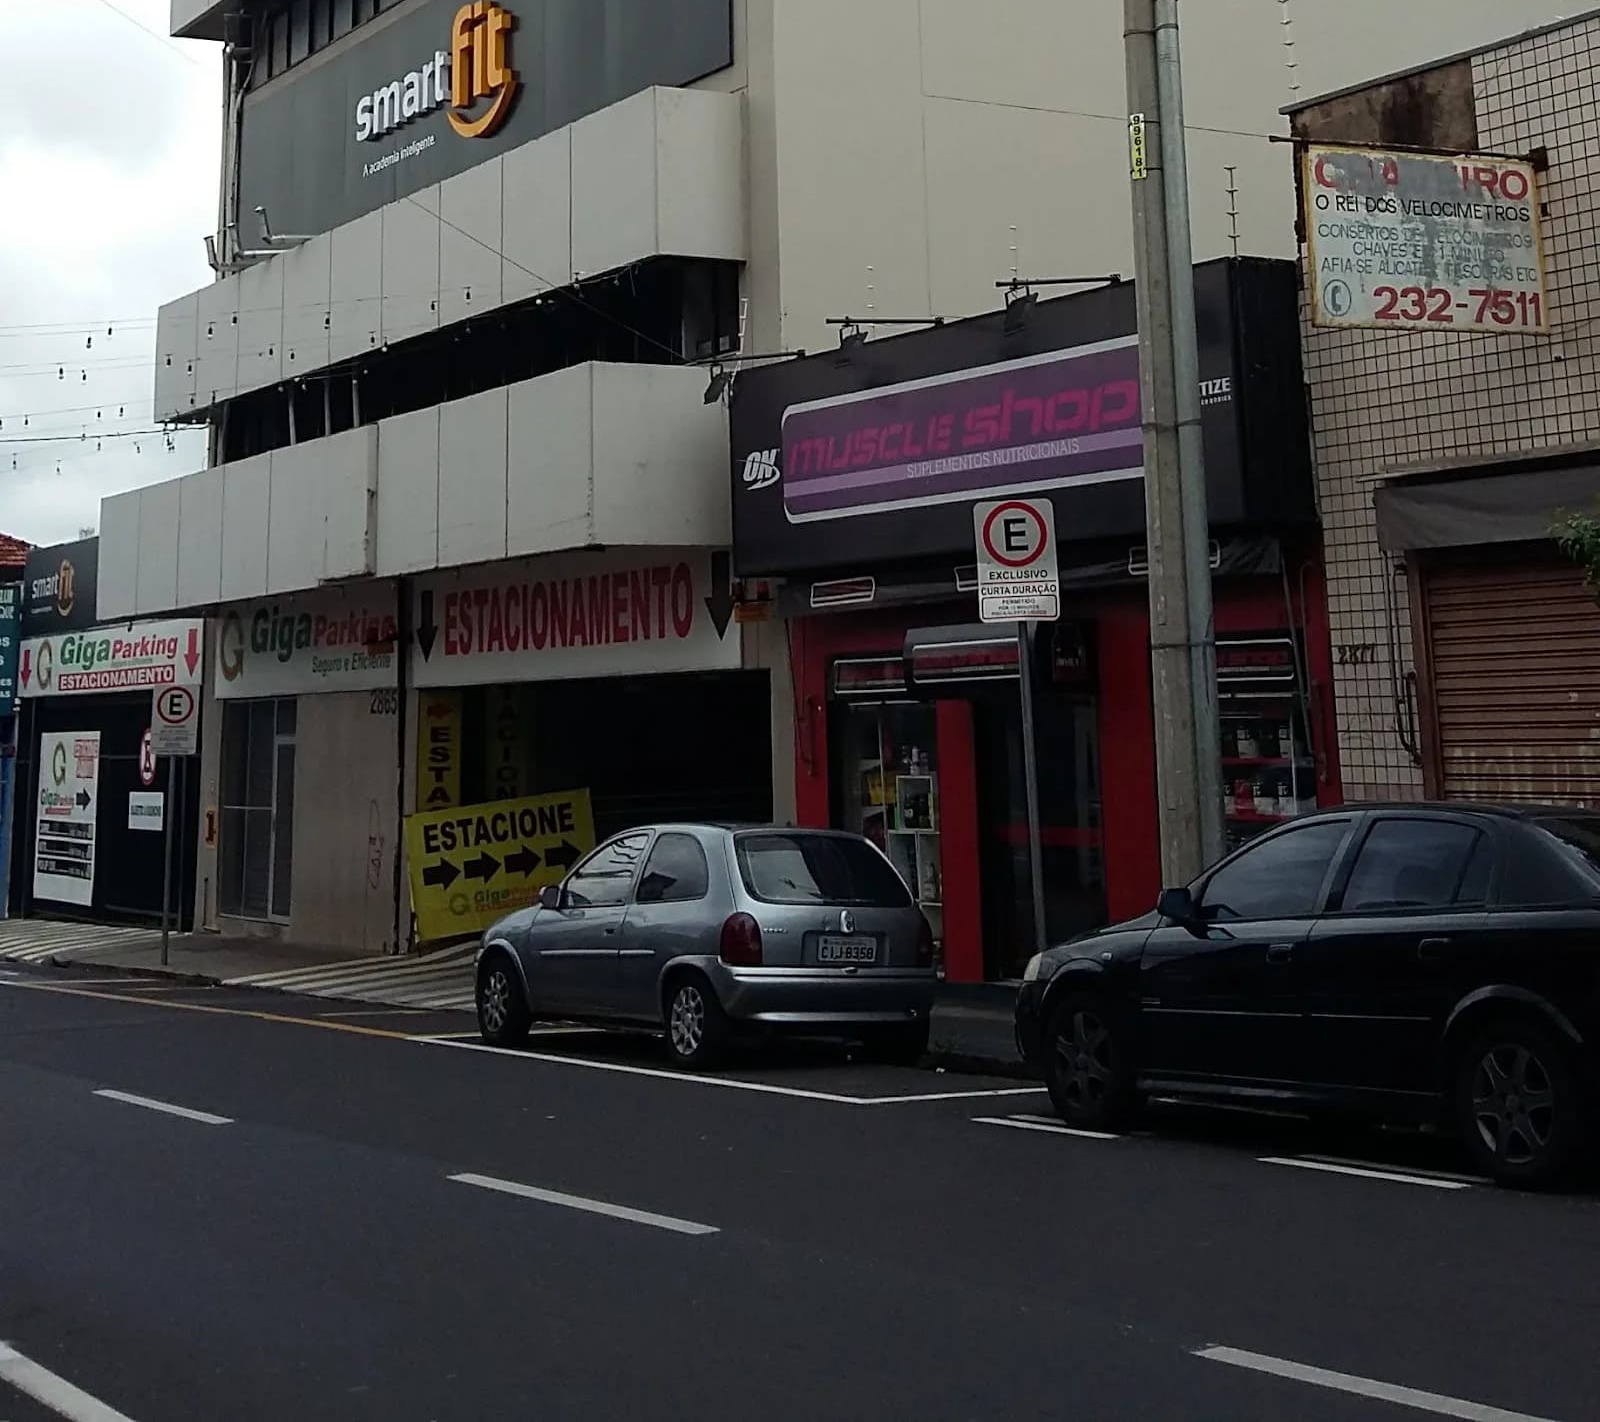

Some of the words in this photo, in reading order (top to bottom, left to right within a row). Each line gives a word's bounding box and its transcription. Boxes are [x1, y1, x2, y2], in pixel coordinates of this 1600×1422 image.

[356, 50, 450, 141] smart
[362, 164, 369, 178] A
[369, 150, 400, 174] academia
[1315, 194, 1329, 210] O
[1335, 195, 1359, 212] REI
[1366, 197, 1397, 213] DOS
[1400, 198, 1530, 222] VELOCIMETROS
[1318, 223, 1398, 241] CONSERTOS
[1353, 241, 1407, 257] CHAVES
[1373, 286, 1543, 326] 232-7511
[743, 449, 780, 482] ON
[907, 453, 990, 478] SUPLEMENTOS
[993, 438, 1080, 466] NUTRICIONAIS
[1003, 518, 1029, 551] E
[32, 573, 58, 599] smart
[989, 570, 1048, 580] EXCLUSIVO
[981, 585, 1010, 595] CURTA
[1012, 583, 1057, 595] DURAÇÃO
[444, 562, 693, 656] ESTACIONAMENTO
[60, 666, 174, 689] ESTACIONAMENTO
[312, 655, 343, 676] Seguro
[344, 657, 349, 667] e
[168, 693, 183, 716] E
[370, 690, 397, 715] 2865
[423, 802, 575, 854] ESTACIONE
